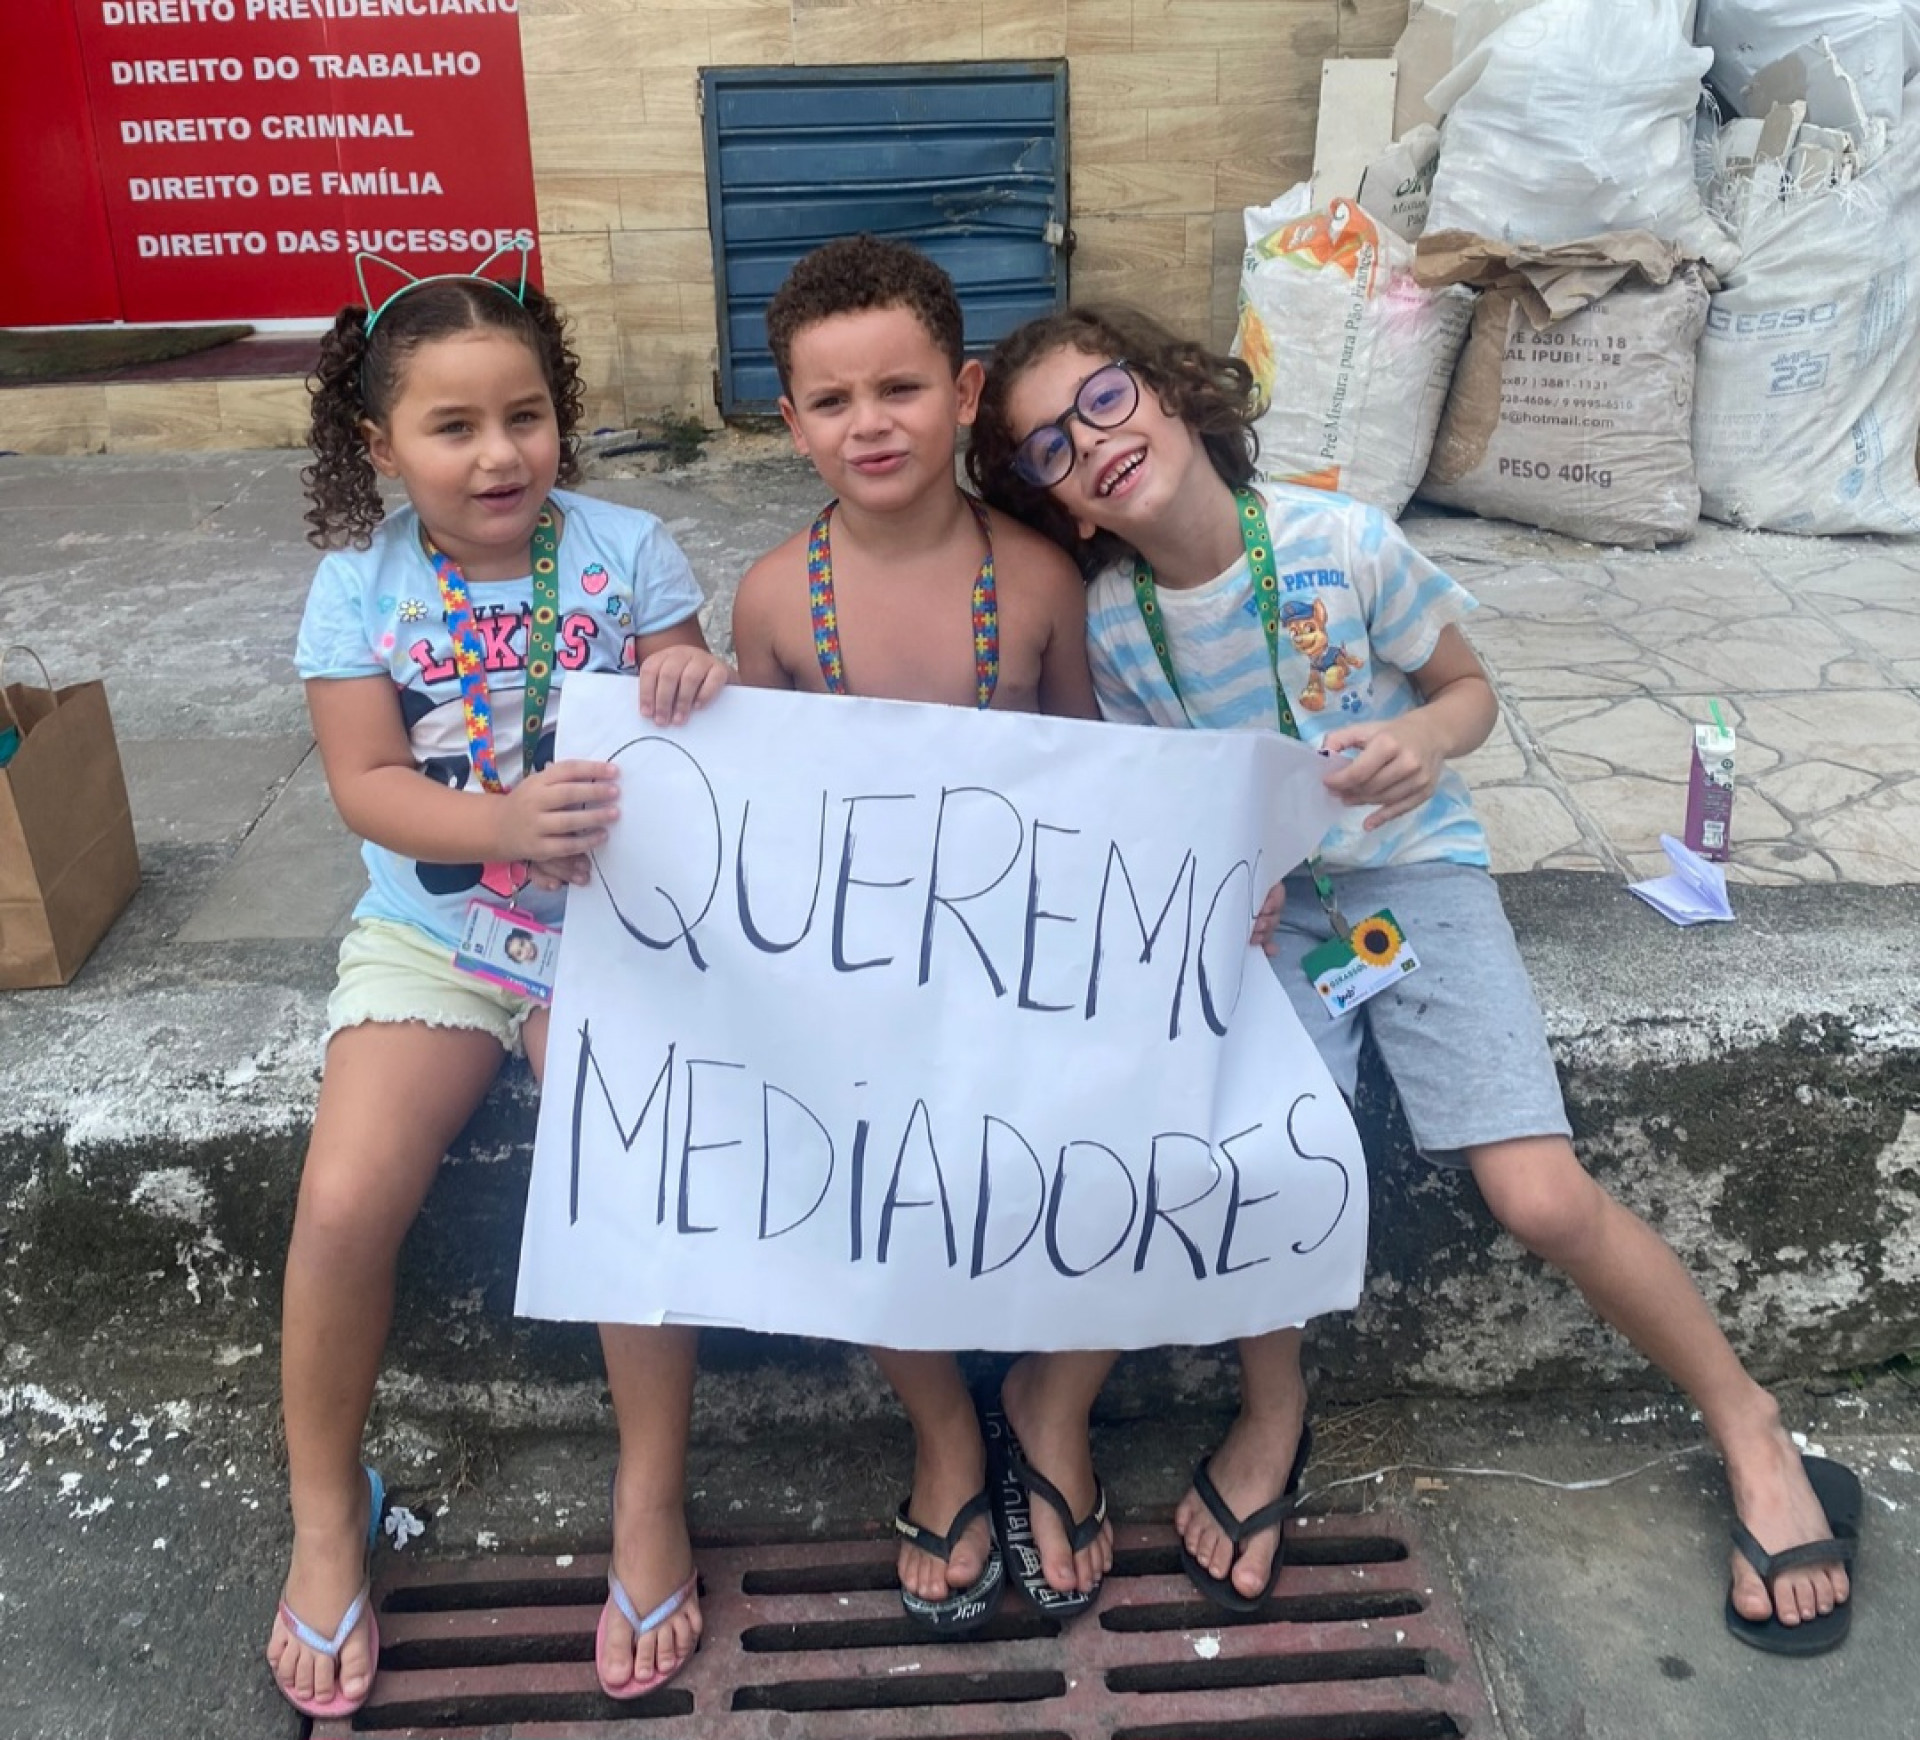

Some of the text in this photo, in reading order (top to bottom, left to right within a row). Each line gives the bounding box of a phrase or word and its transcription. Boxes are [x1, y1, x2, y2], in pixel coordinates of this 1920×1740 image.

[103, 0, 235, 25] DIREITO
[111, 52, 481, 84] DIREITO DO TRABALHO
[120, 114, 414, 143] DIREITO CRIMINAL
[129, 167, 443, 200] DIREITO DE FAMÍLIA
[137, 232, 267, 257] DIREITO
[276, 230, 340, 253] DAS
[1346, 303, 1362, 331] Pão
[1707, 302, 1837, 333] GESSO
[1340, 336, 1355, 369] para
[1532, 333, 1564, 345] 630
[1571, 334, 1599, 348] km
[1607, 336, 1626, 349] 18
[1325, 371, 1348, 430] Mistura
[1321, 431, 1338, 459] Pré
[1500, 457, 1613, 488] PESO 40kg
[1282, 568, 1349, 592] PATROL
